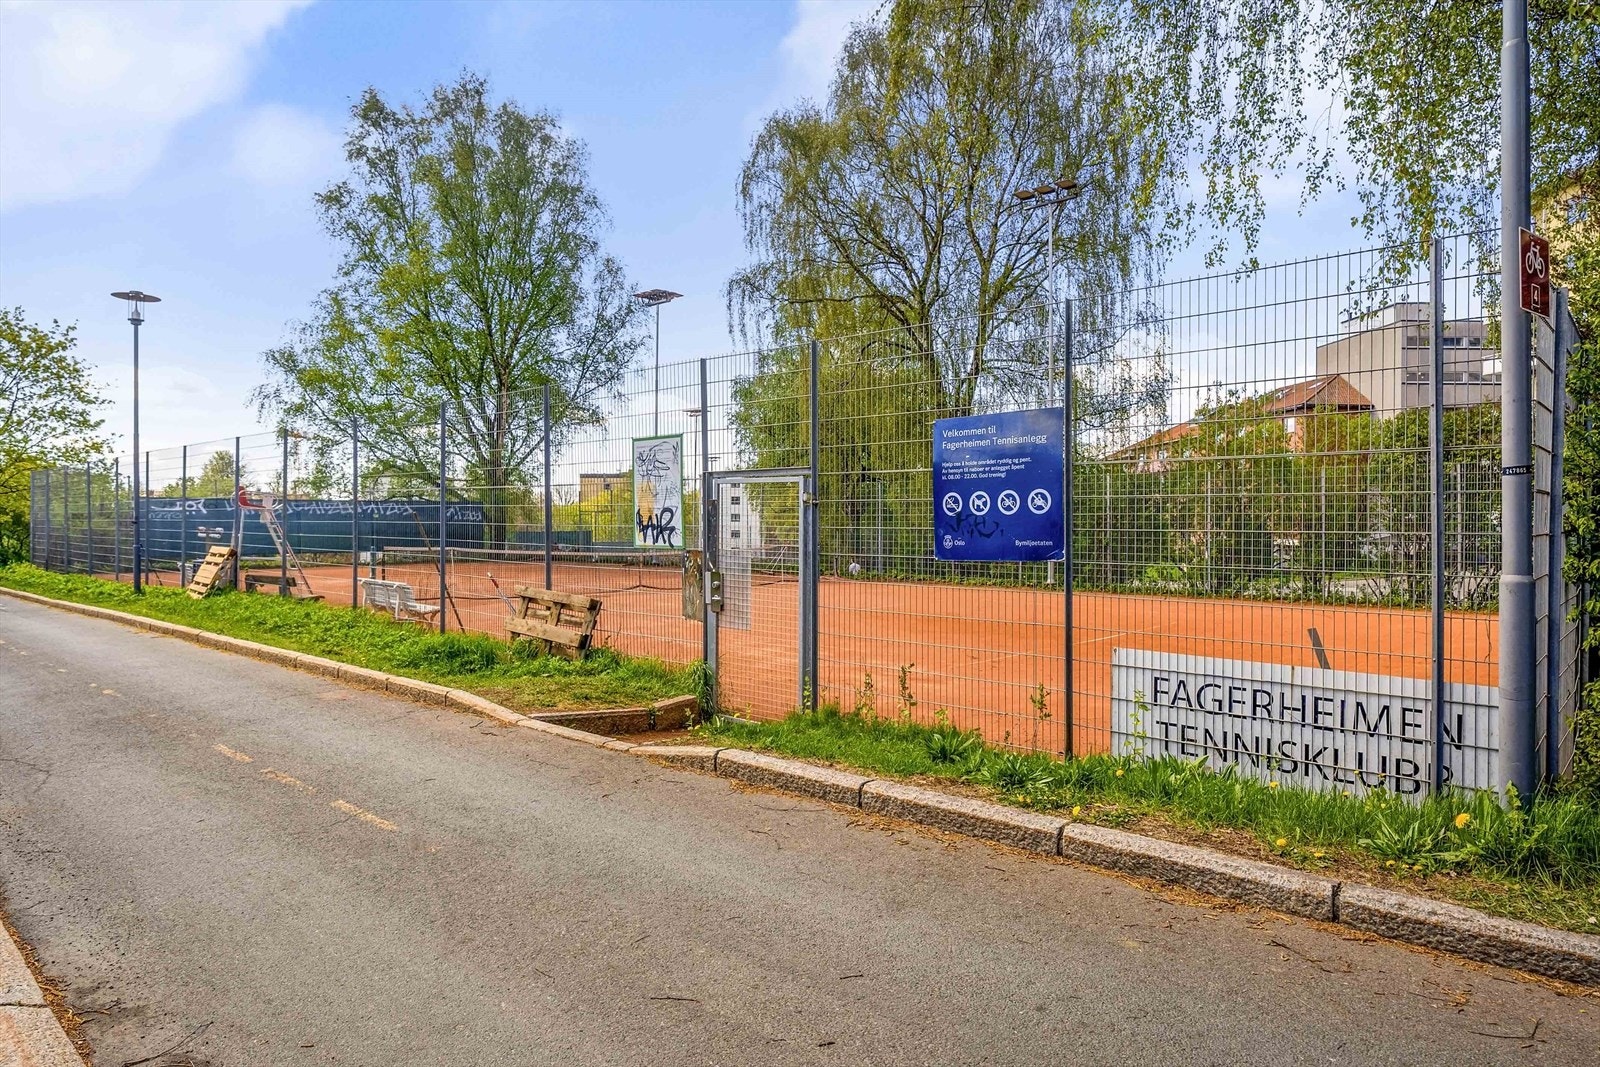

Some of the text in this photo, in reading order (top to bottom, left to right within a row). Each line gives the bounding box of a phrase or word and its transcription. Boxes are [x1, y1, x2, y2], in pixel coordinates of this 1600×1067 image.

[1534, 289, 1538, 302] 4
[942, 425, 997, 438] Velkommen til
[942, 434, 1048, 450] Fagerheimen Tennisanlegg
[1015, 539, 1053, 548] Bymiljøetaten
